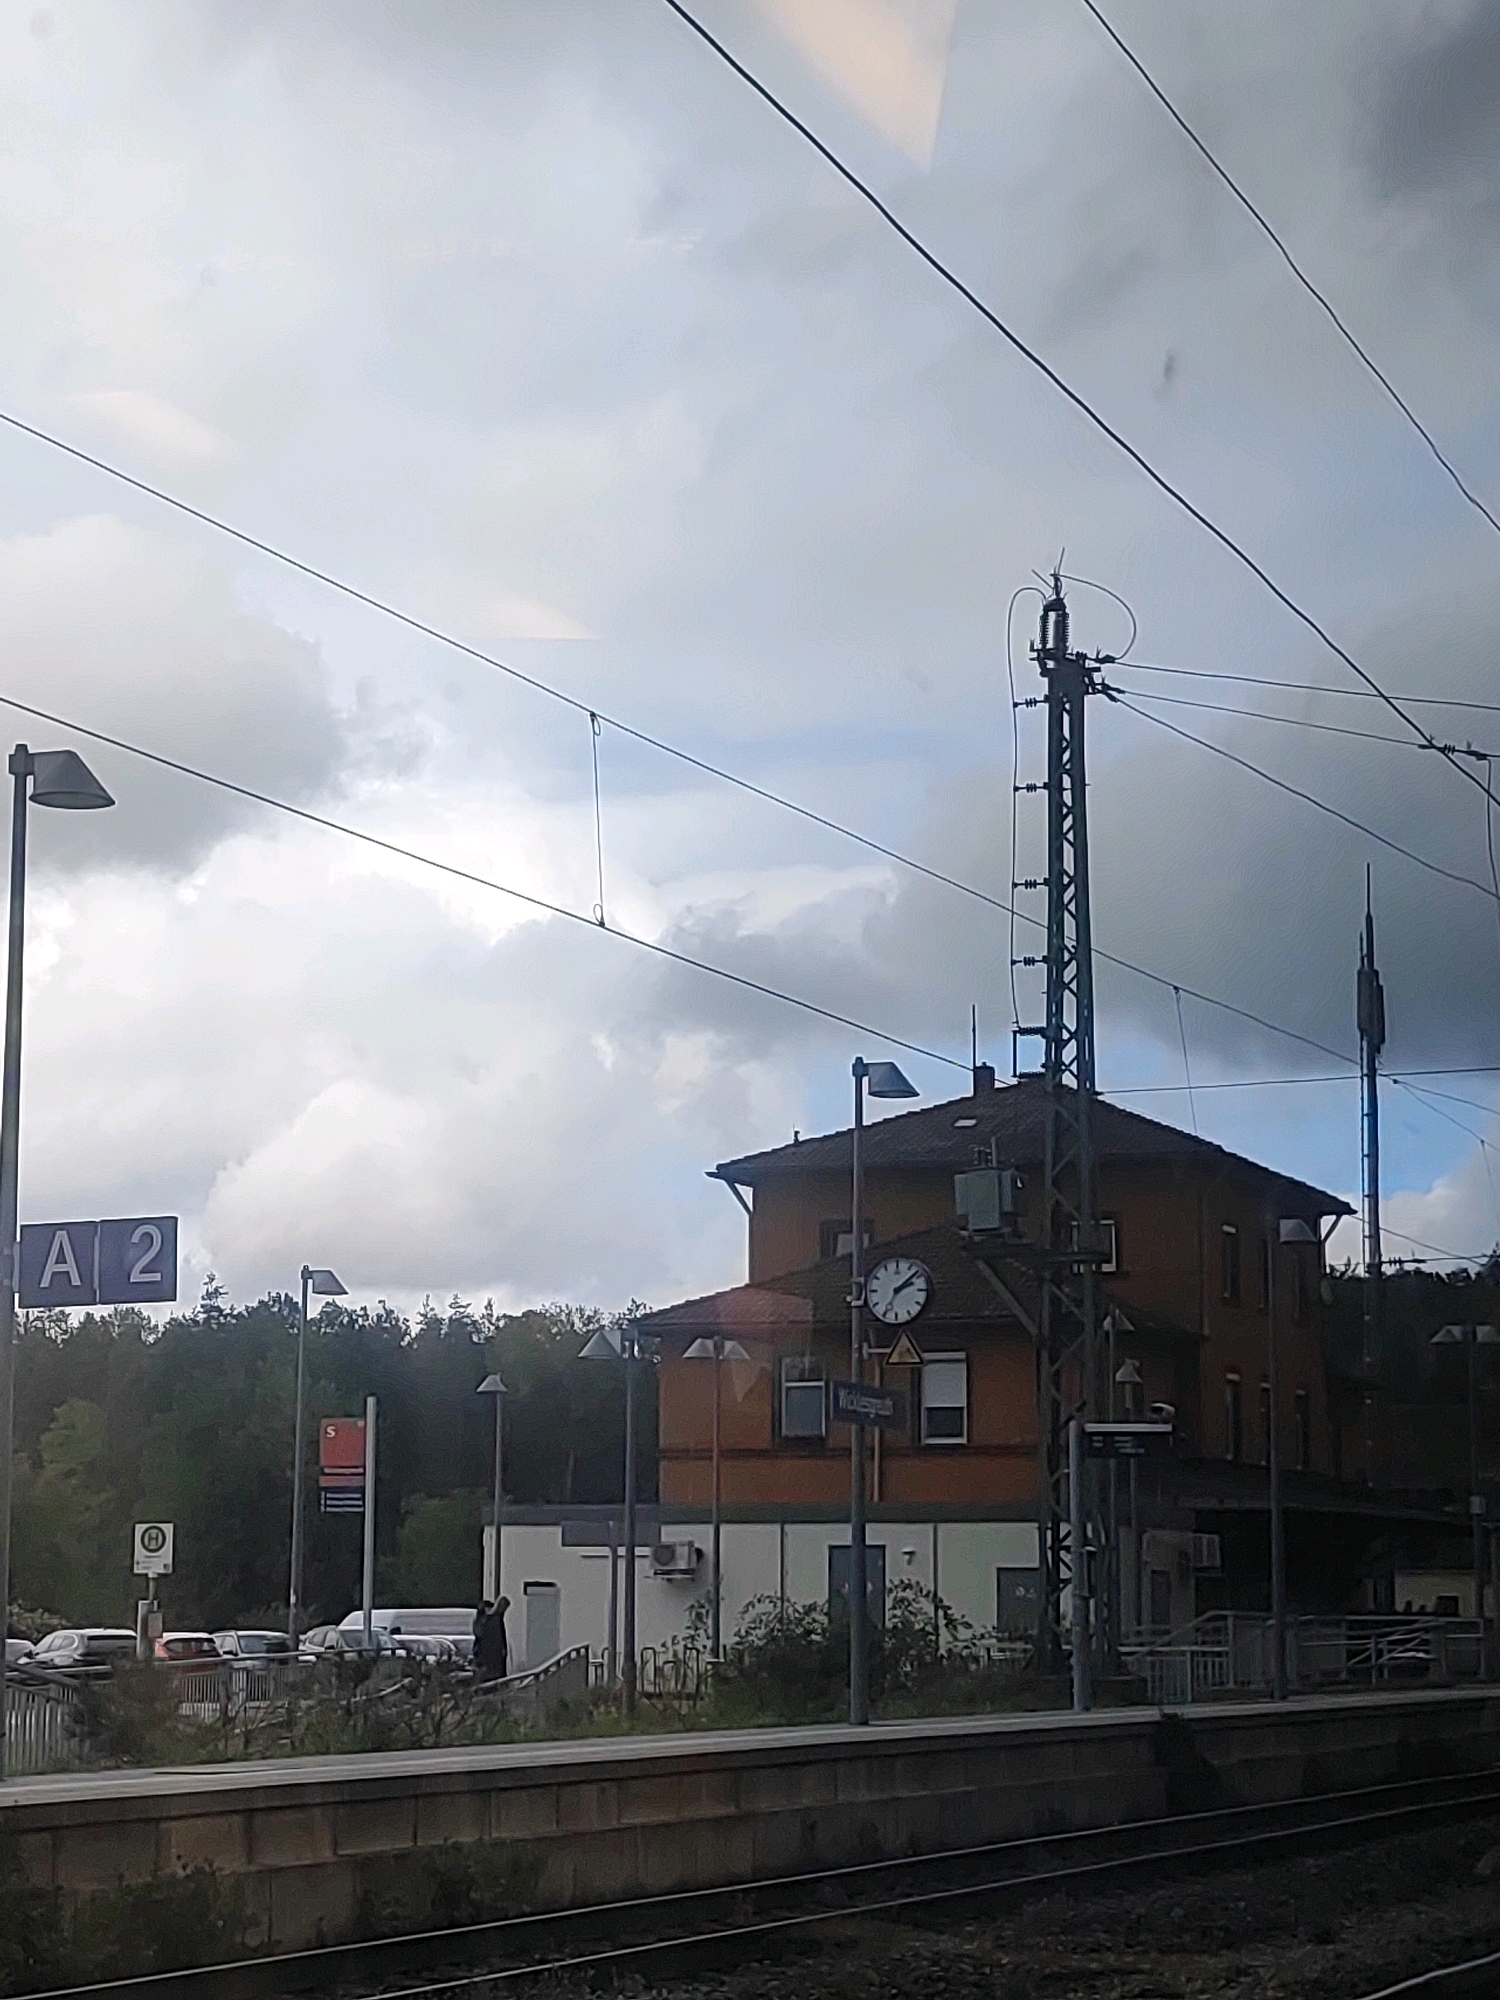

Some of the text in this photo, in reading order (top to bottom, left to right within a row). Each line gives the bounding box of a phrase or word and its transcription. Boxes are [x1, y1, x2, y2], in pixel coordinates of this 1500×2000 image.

[40, 1225, 162, 1287] A 2
[326, 1425, 336, 1438] S
[148, 1531, 159, 1547] H
